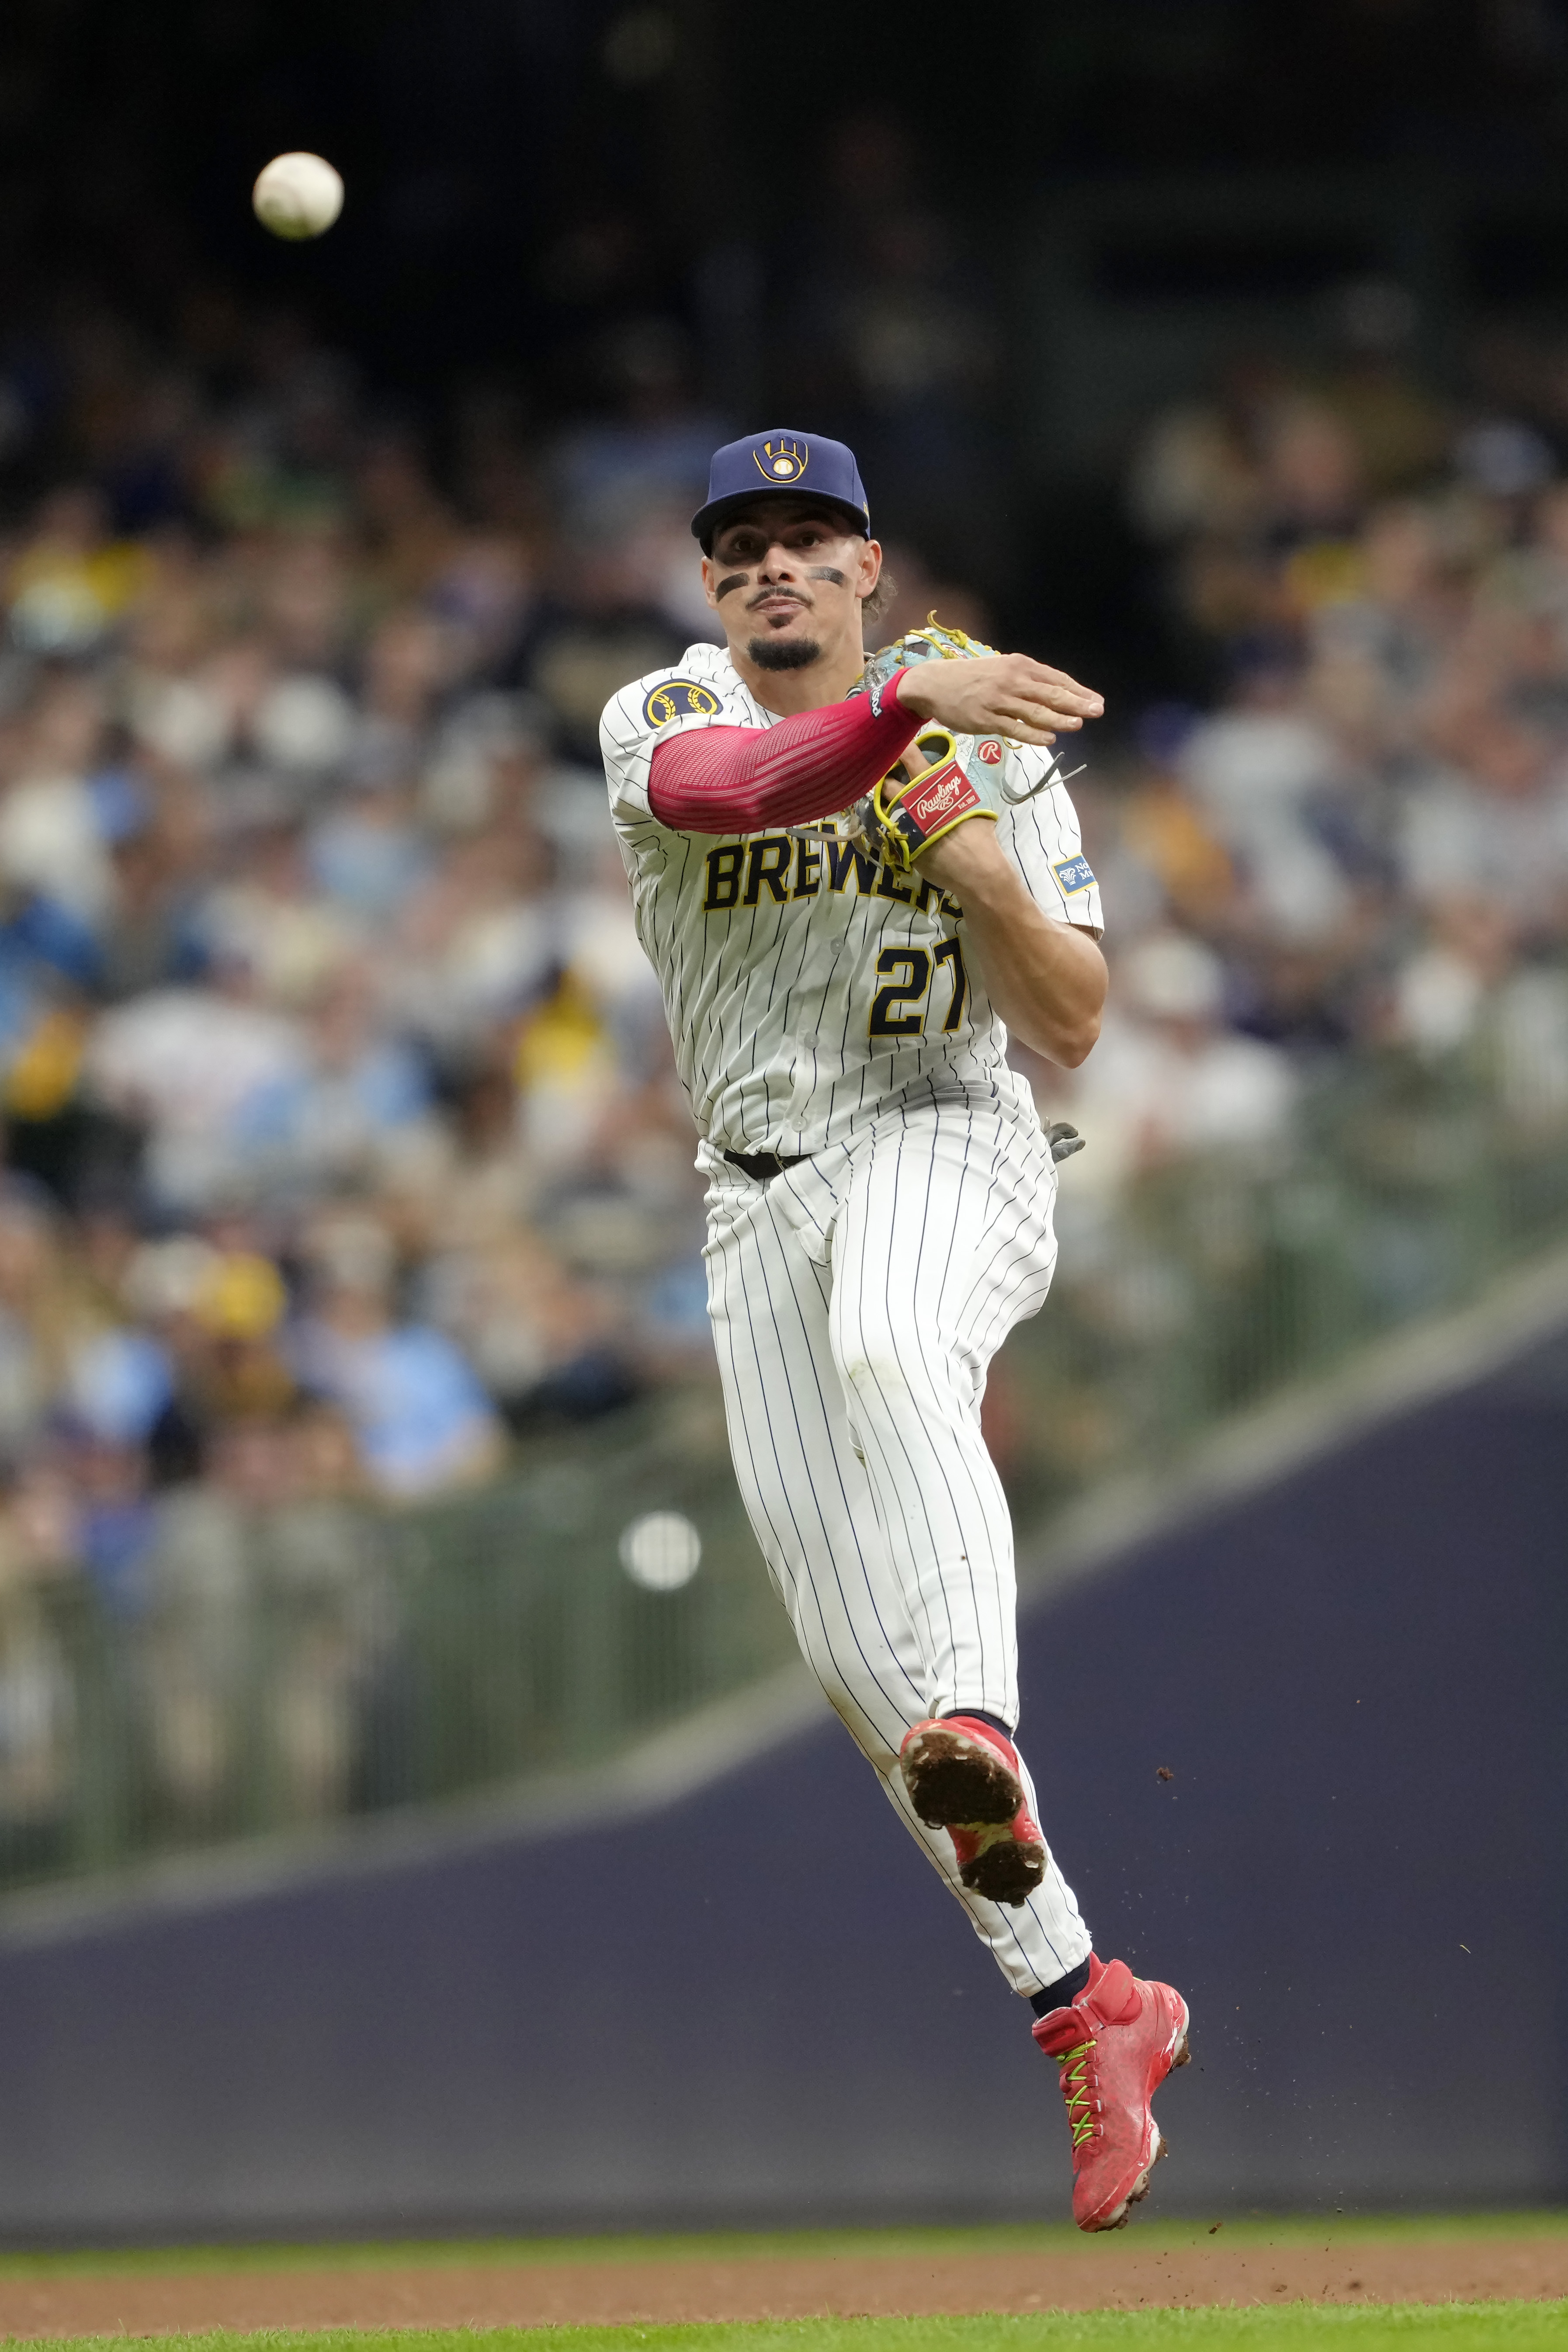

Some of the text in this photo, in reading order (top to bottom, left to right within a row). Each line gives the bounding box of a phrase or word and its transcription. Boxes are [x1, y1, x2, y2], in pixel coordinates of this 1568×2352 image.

[979, 742, 1000, 761] R
[917, 776, 961, 820] Rawlings
[867, 934, 967, 1037] 27
